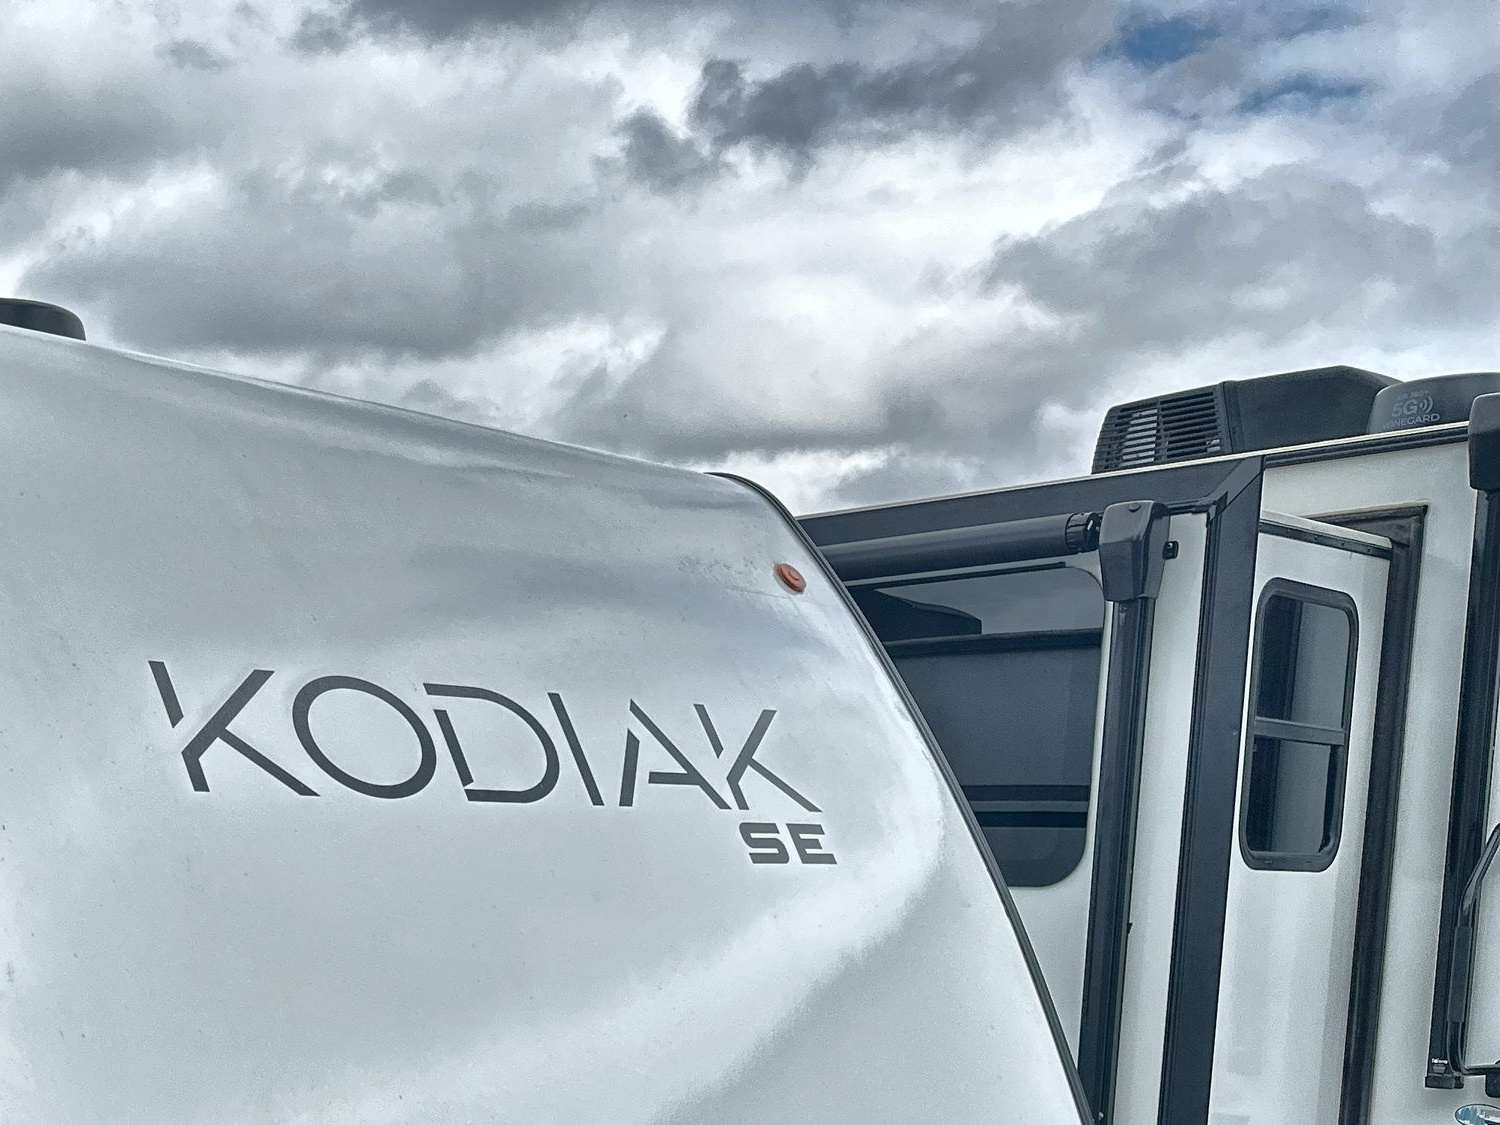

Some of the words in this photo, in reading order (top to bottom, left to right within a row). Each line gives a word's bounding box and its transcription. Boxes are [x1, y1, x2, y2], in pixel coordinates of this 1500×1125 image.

[1391, 399, 1419, 418] 5G
[148, 660, 823, 813] KODIAK
[739, 822, 837, 864] SE
